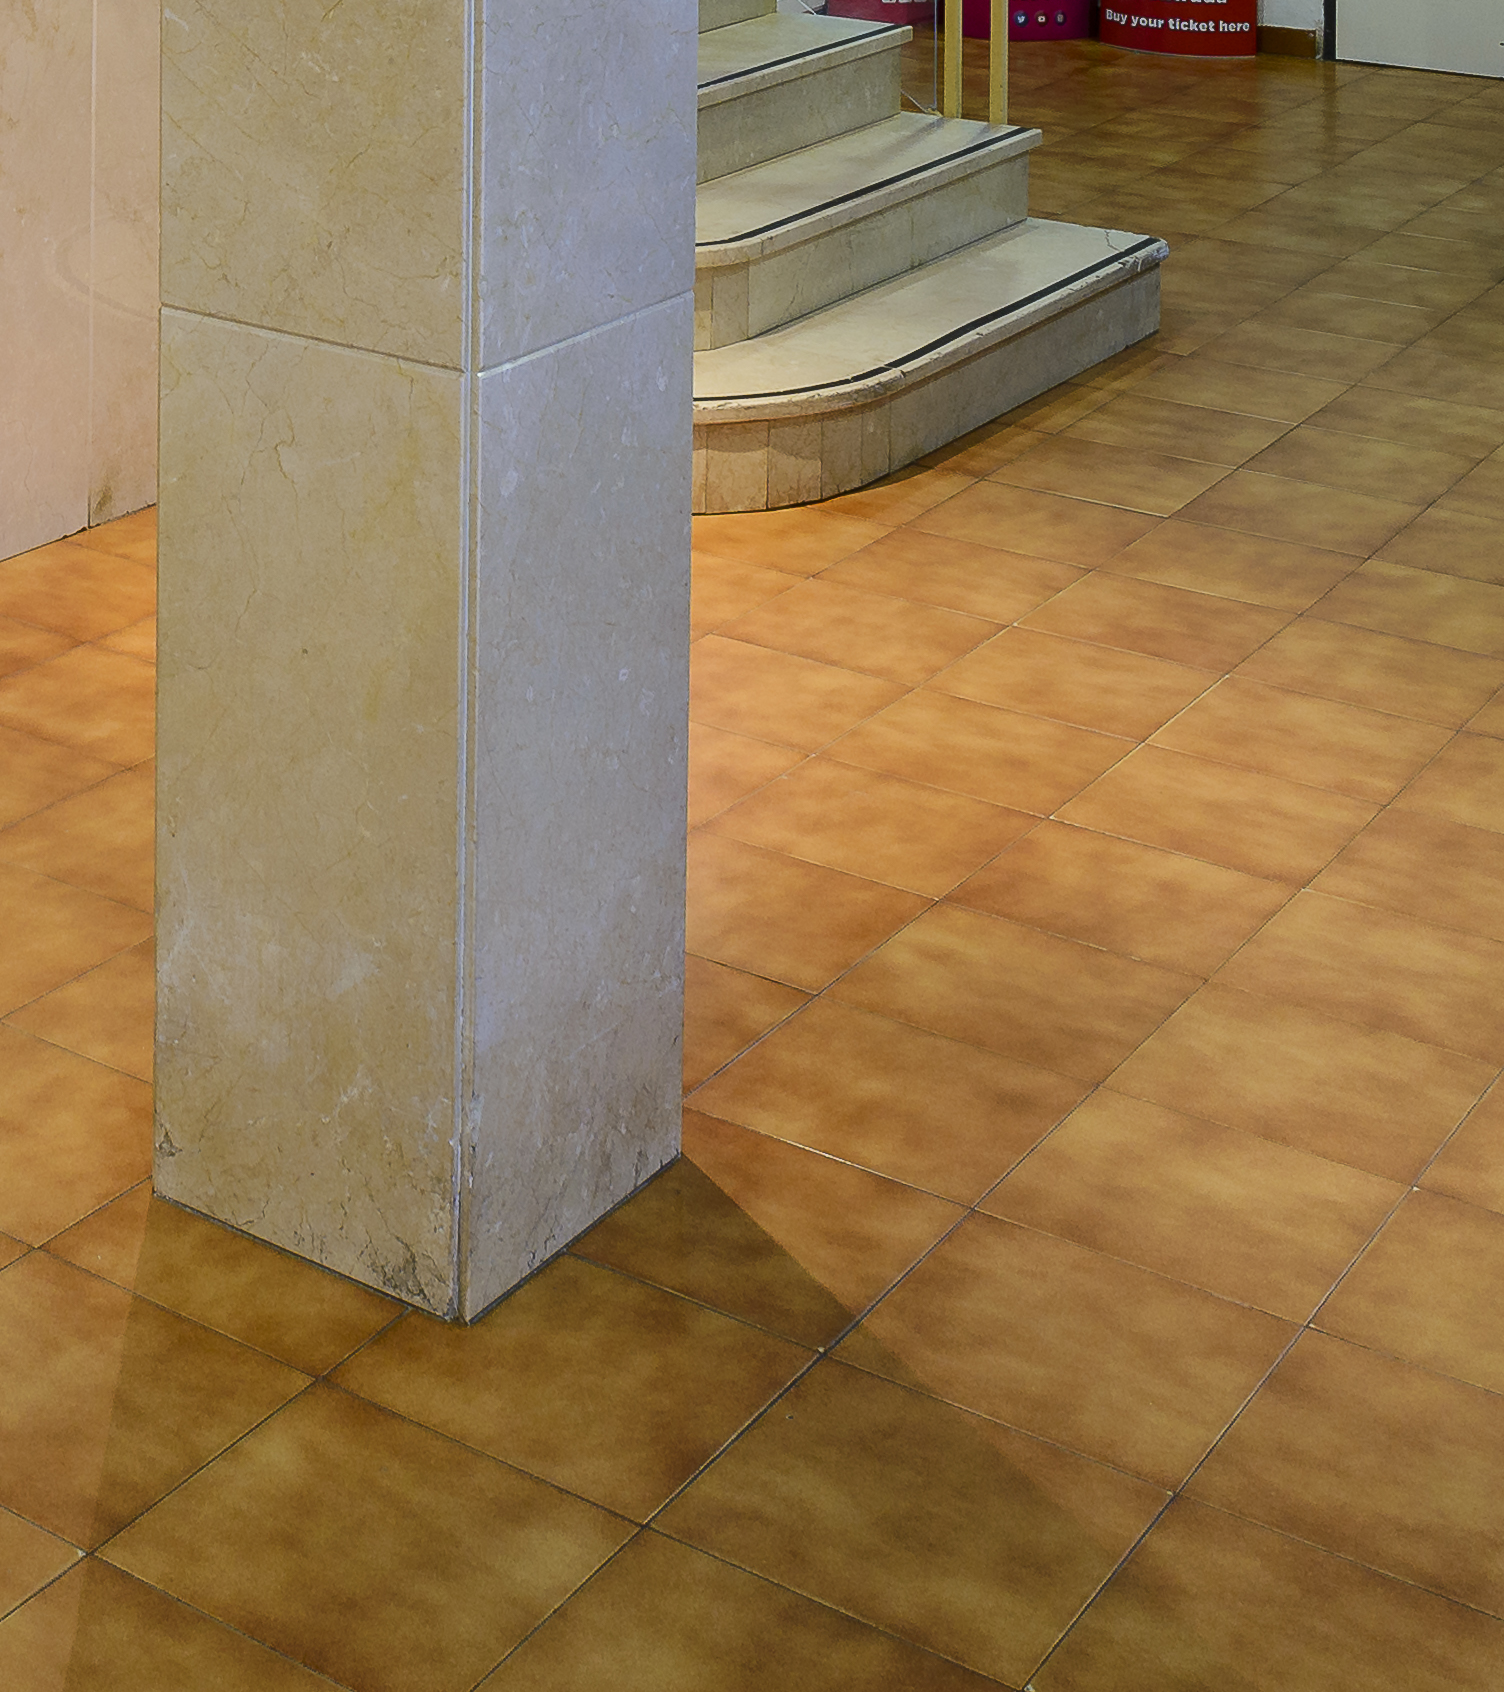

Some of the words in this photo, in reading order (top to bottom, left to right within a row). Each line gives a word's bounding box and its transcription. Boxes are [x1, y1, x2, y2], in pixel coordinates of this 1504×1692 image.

[1106, 9, 1127, 24] Buy
[1131, 15, 1164, 26] your
[1168, 19, 1215, 31] ticket
[1219, 21, 1250, 32] here
